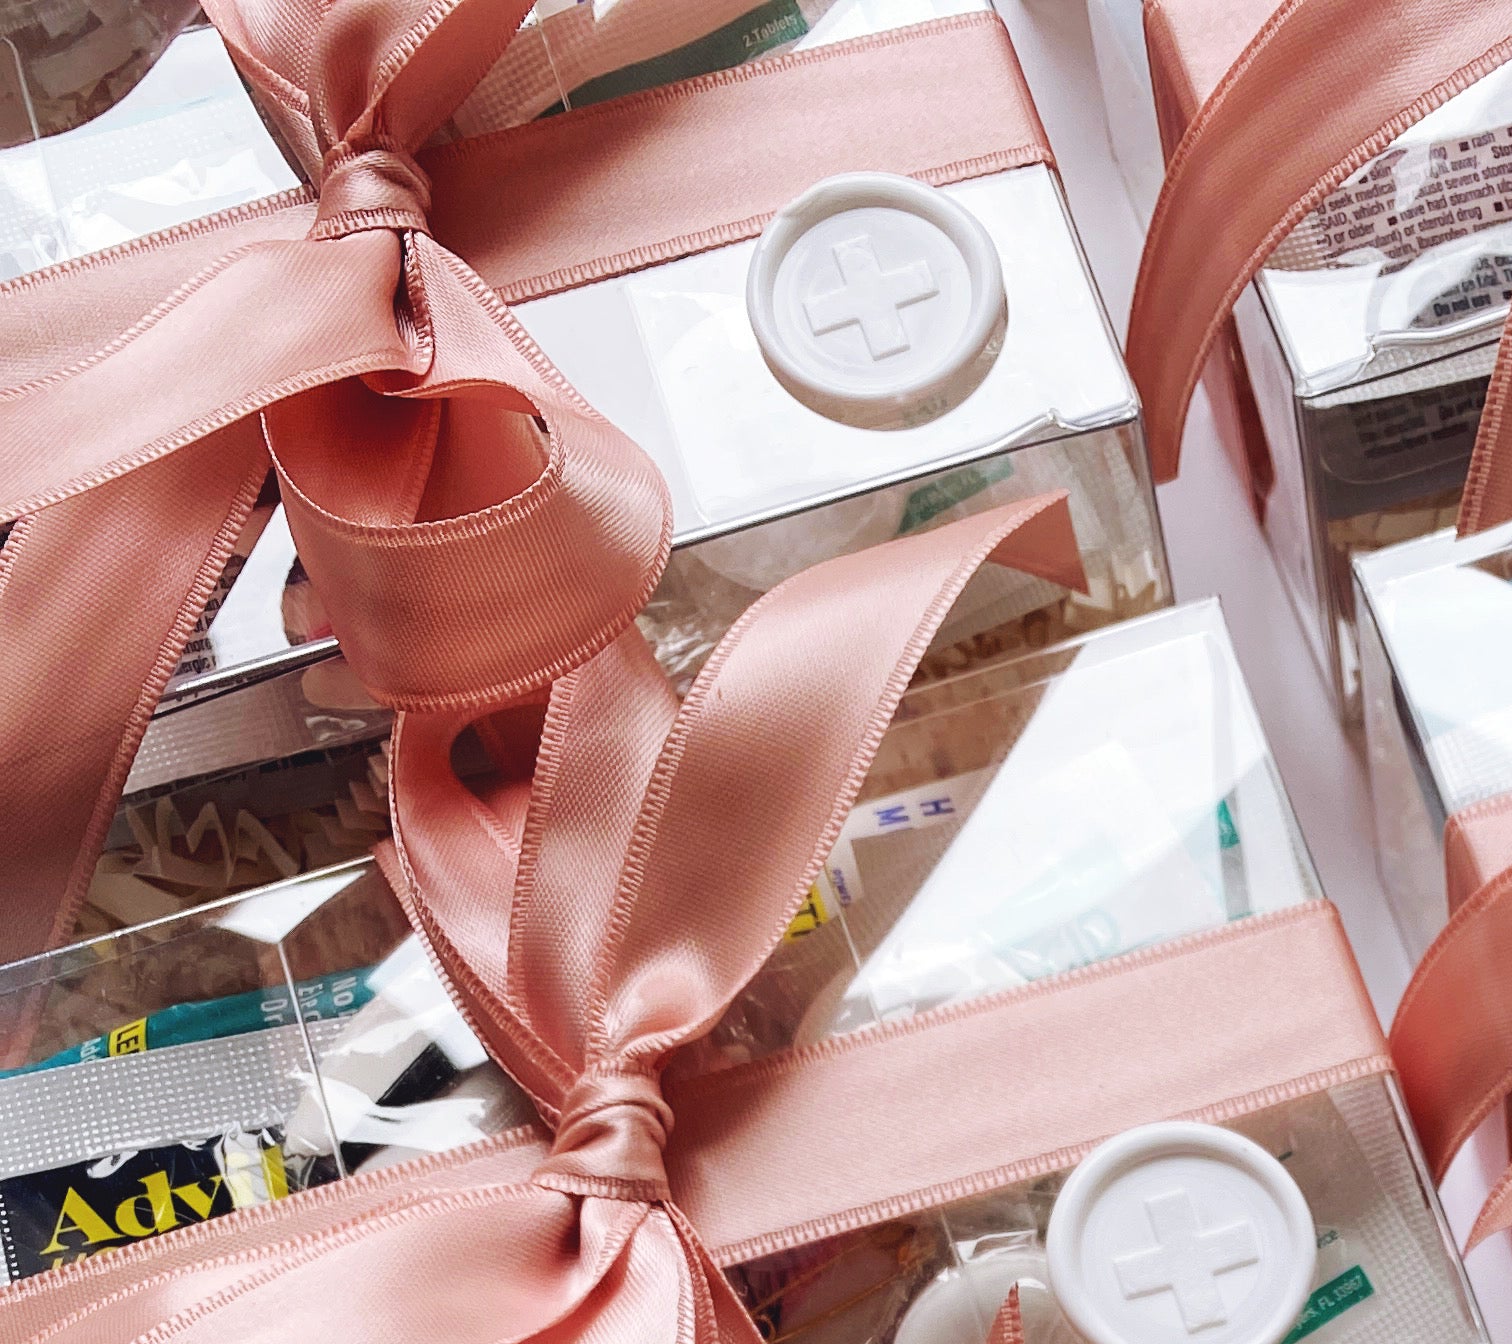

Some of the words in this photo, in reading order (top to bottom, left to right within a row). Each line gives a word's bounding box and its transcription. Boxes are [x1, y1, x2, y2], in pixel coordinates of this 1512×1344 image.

[743, 34, 753, 48] 2
[752, 13, 798, 47] Tablets
[1471, 132, 1495, 147] rash
[1327, 192, 1352, 209] seek
[1354, 203, 1383, 218] which
[1446, 172, 1478, 188] severe
[1333, 231, 1345, 242] or
[1348, 221, 1375, 237] older
[1427, 197, 1446, 211] had
[1451, 186, 1493, 204] stomach
[1404, 226, 1414, 235] or
[1419, 214, 1452, 230] steroid
[1457, 205, 1482, 222] drug
